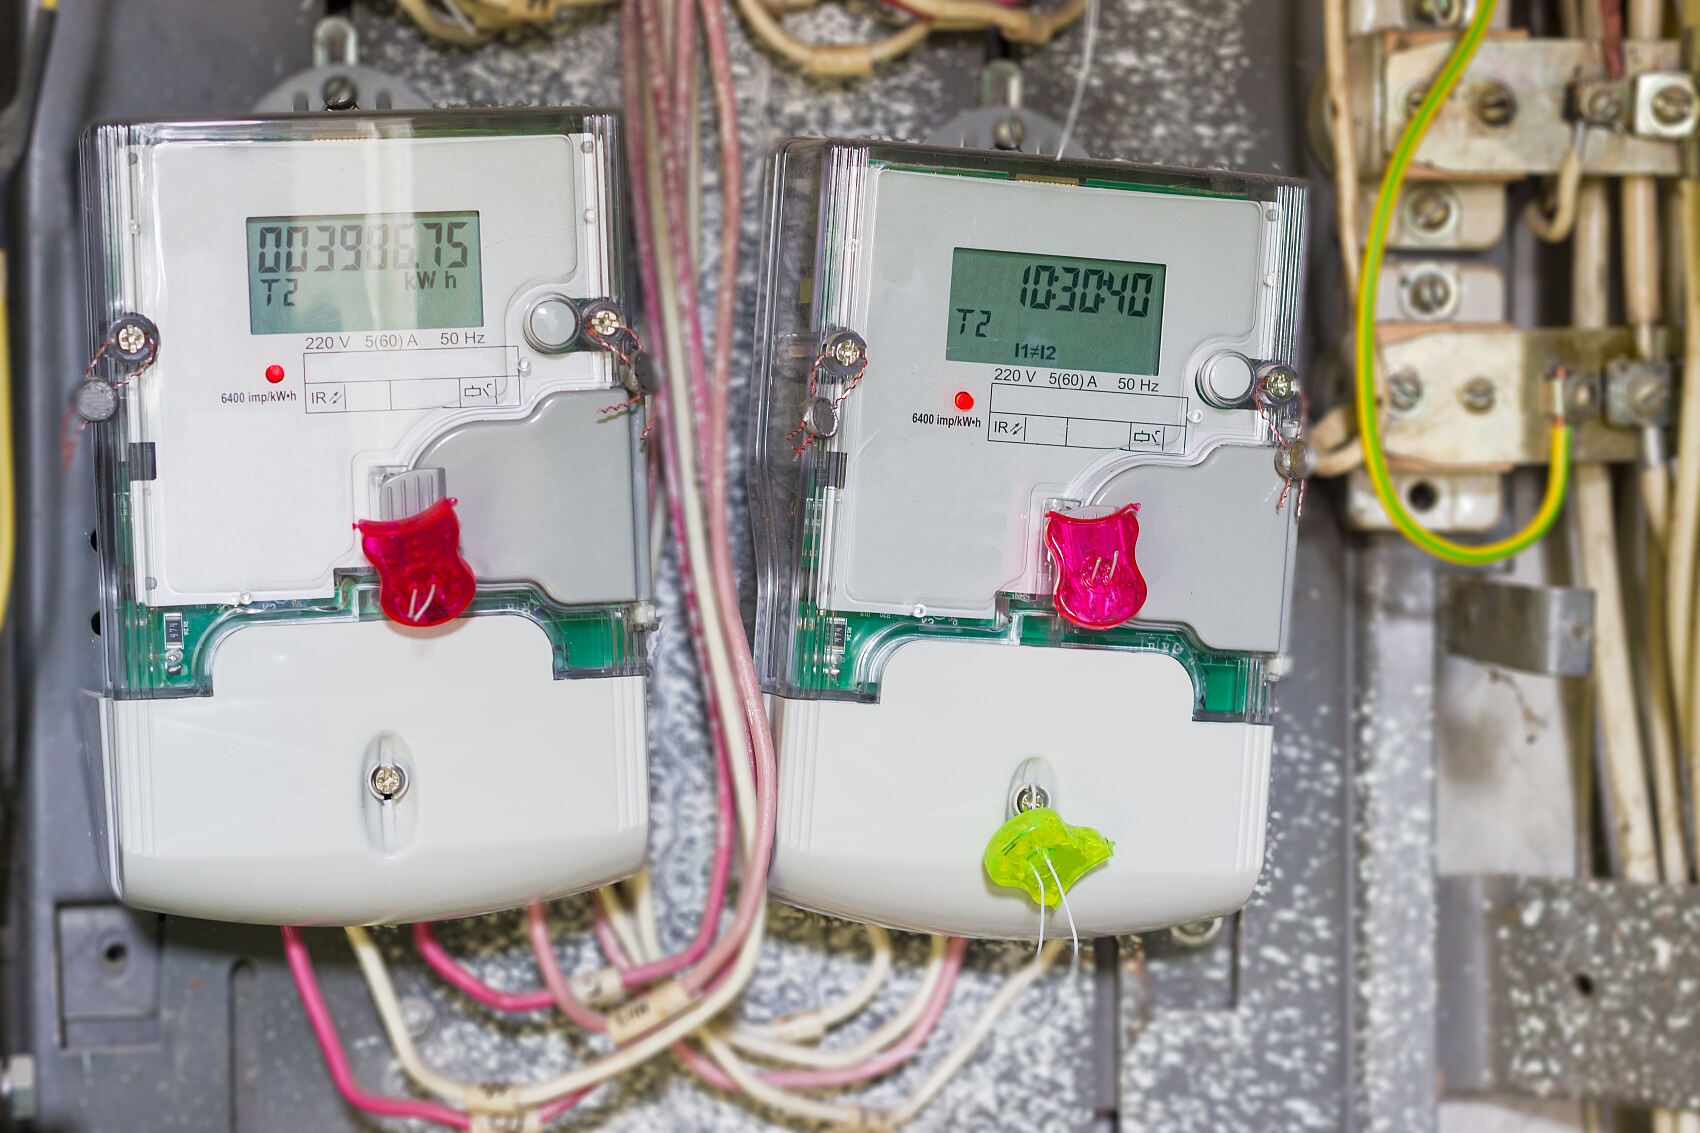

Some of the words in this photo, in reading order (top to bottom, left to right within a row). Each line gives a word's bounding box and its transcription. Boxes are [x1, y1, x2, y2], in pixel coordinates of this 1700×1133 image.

[260, 278, 298, 307] T2
[1019, 264, 1153, 318] 10:30:40
[956, 308, 992, 338] T2
[305, 337, 334, 350] 220
[335, 336, 351, 348] V
[365, 334, 403, 351] 5(60)
[407, 334, 419, 347] A
[440, 332, 459, 345] 50
[464, 331, 486, 344] Hz
[994, 367, 1021, 382] 220
[1025, 370, 1037, 383] V
[1048, 372, 1084, 390] 5(60)
[1087, 375, 1098, 388] A
[1117, 377, 1135, 391] 50
[1140, 378, 1160, 392] Hz
[221, 392, 245, 404] 6400
[311, 391, 327, 404] IR
[911, 412, 934, 426] 6400
[994, 421, 1008, 434] IR
